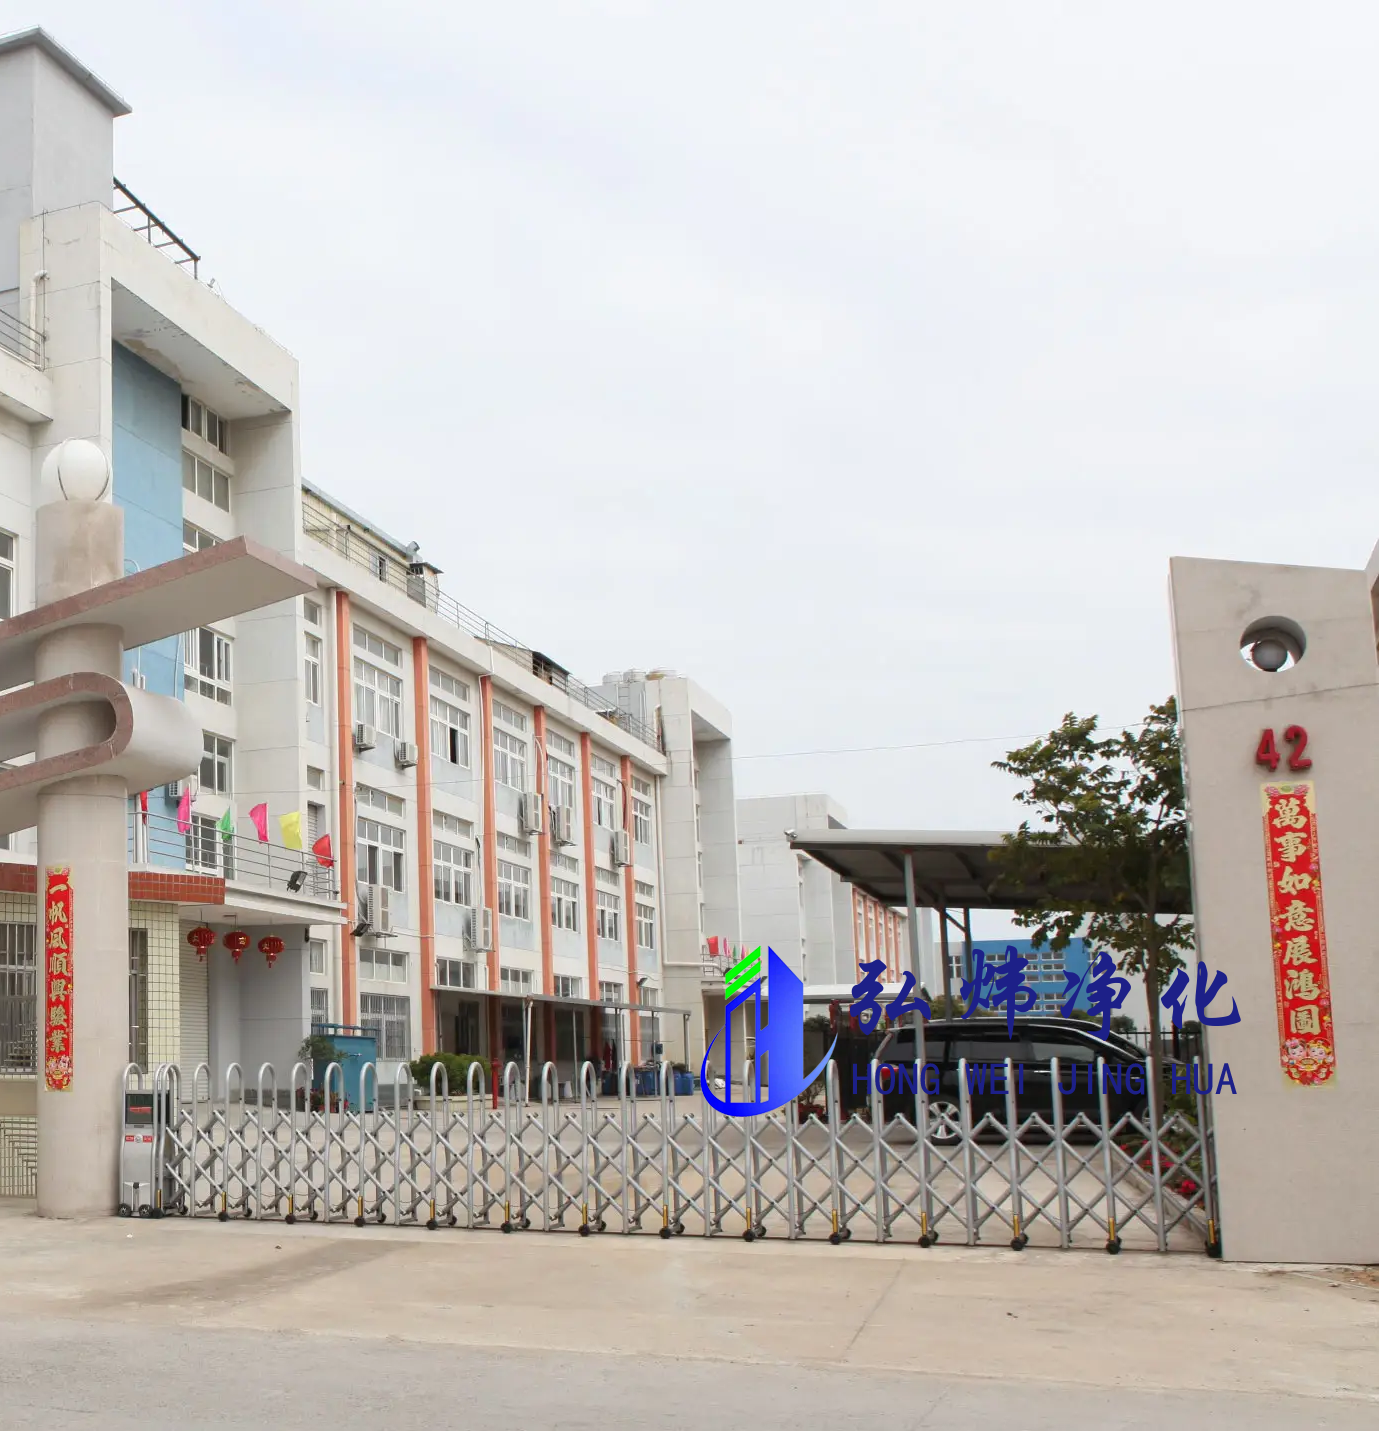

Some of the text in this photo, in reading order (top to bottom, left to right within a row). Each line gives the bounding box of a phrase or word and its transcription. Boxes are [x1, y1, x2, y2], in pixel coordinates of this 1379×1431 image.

[1256, 725, 1312, 772] 42
[1272, 798, 1322, 1036] 萬事如意展鴻圖
